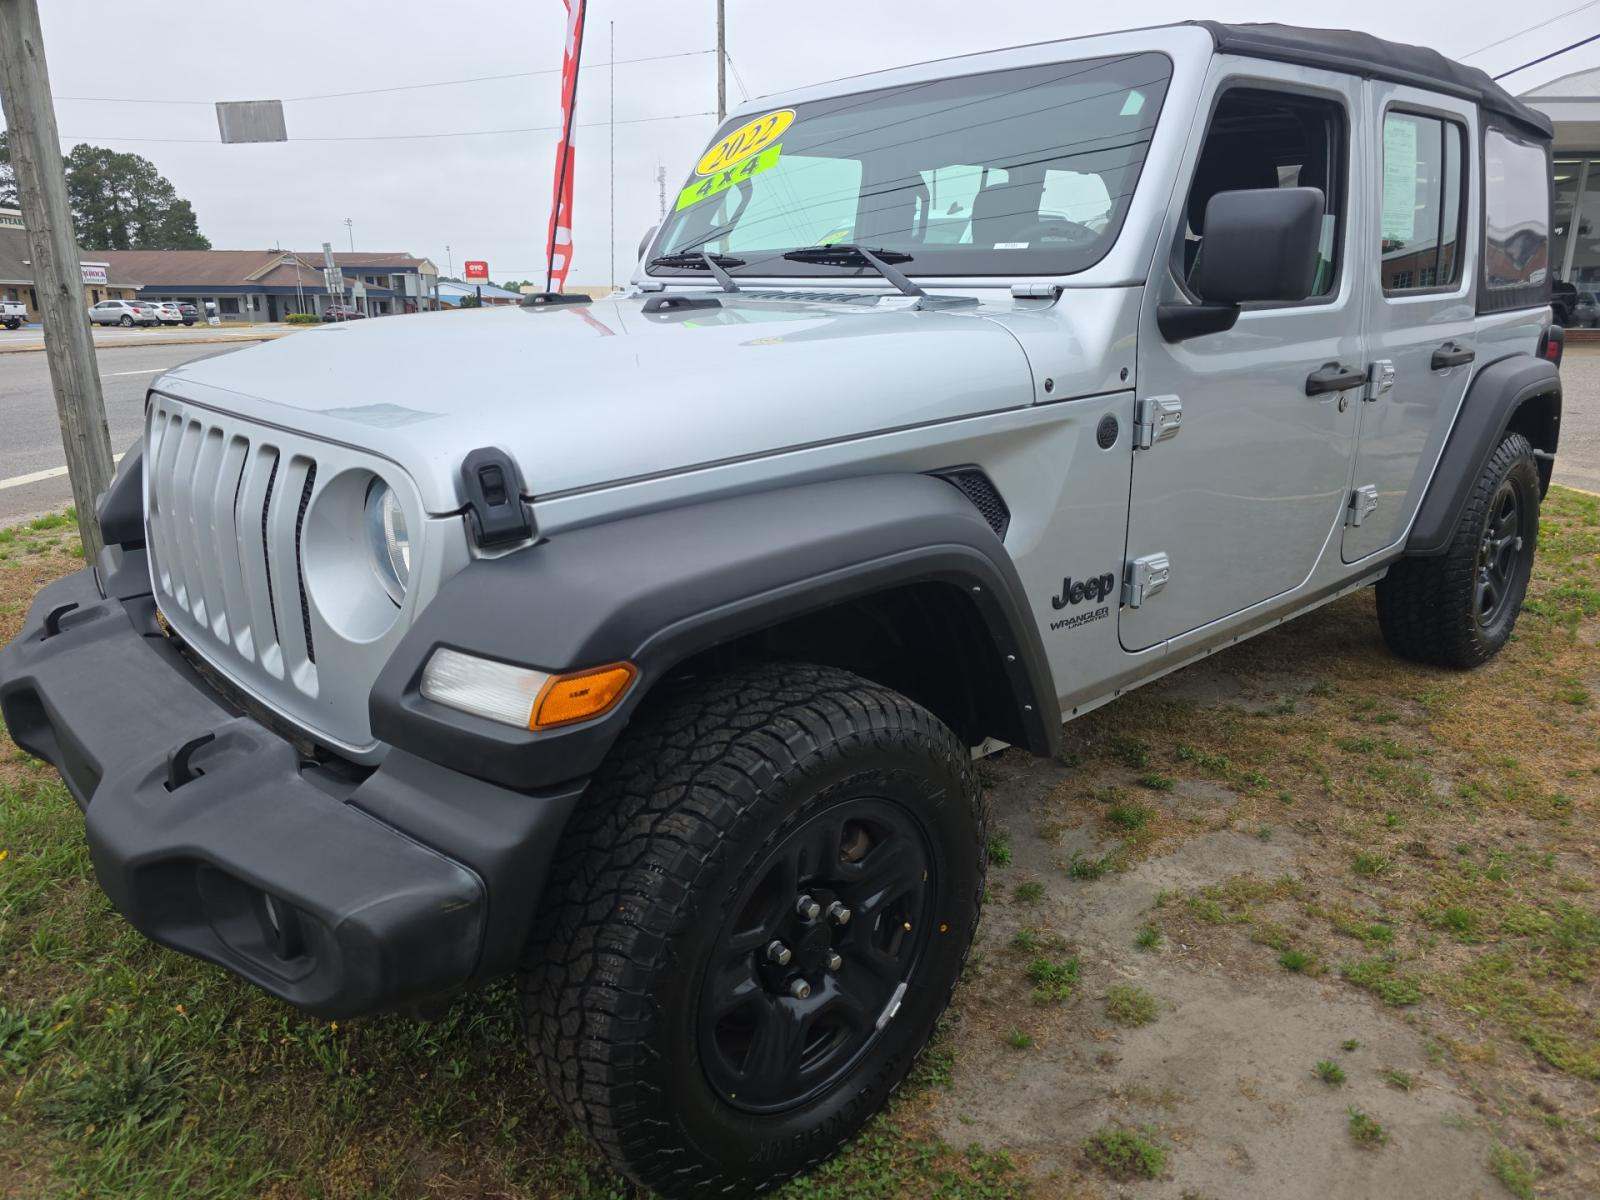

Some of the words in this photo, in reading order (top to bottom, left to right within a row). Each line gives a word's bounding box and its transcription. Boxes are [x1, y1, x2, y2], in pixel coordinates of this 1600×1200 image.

[706, 115, 779, 171] 2022
[1051, 572, 1115, 610] Jeep
[1050, 606, 1109, 631] WRANGLER
